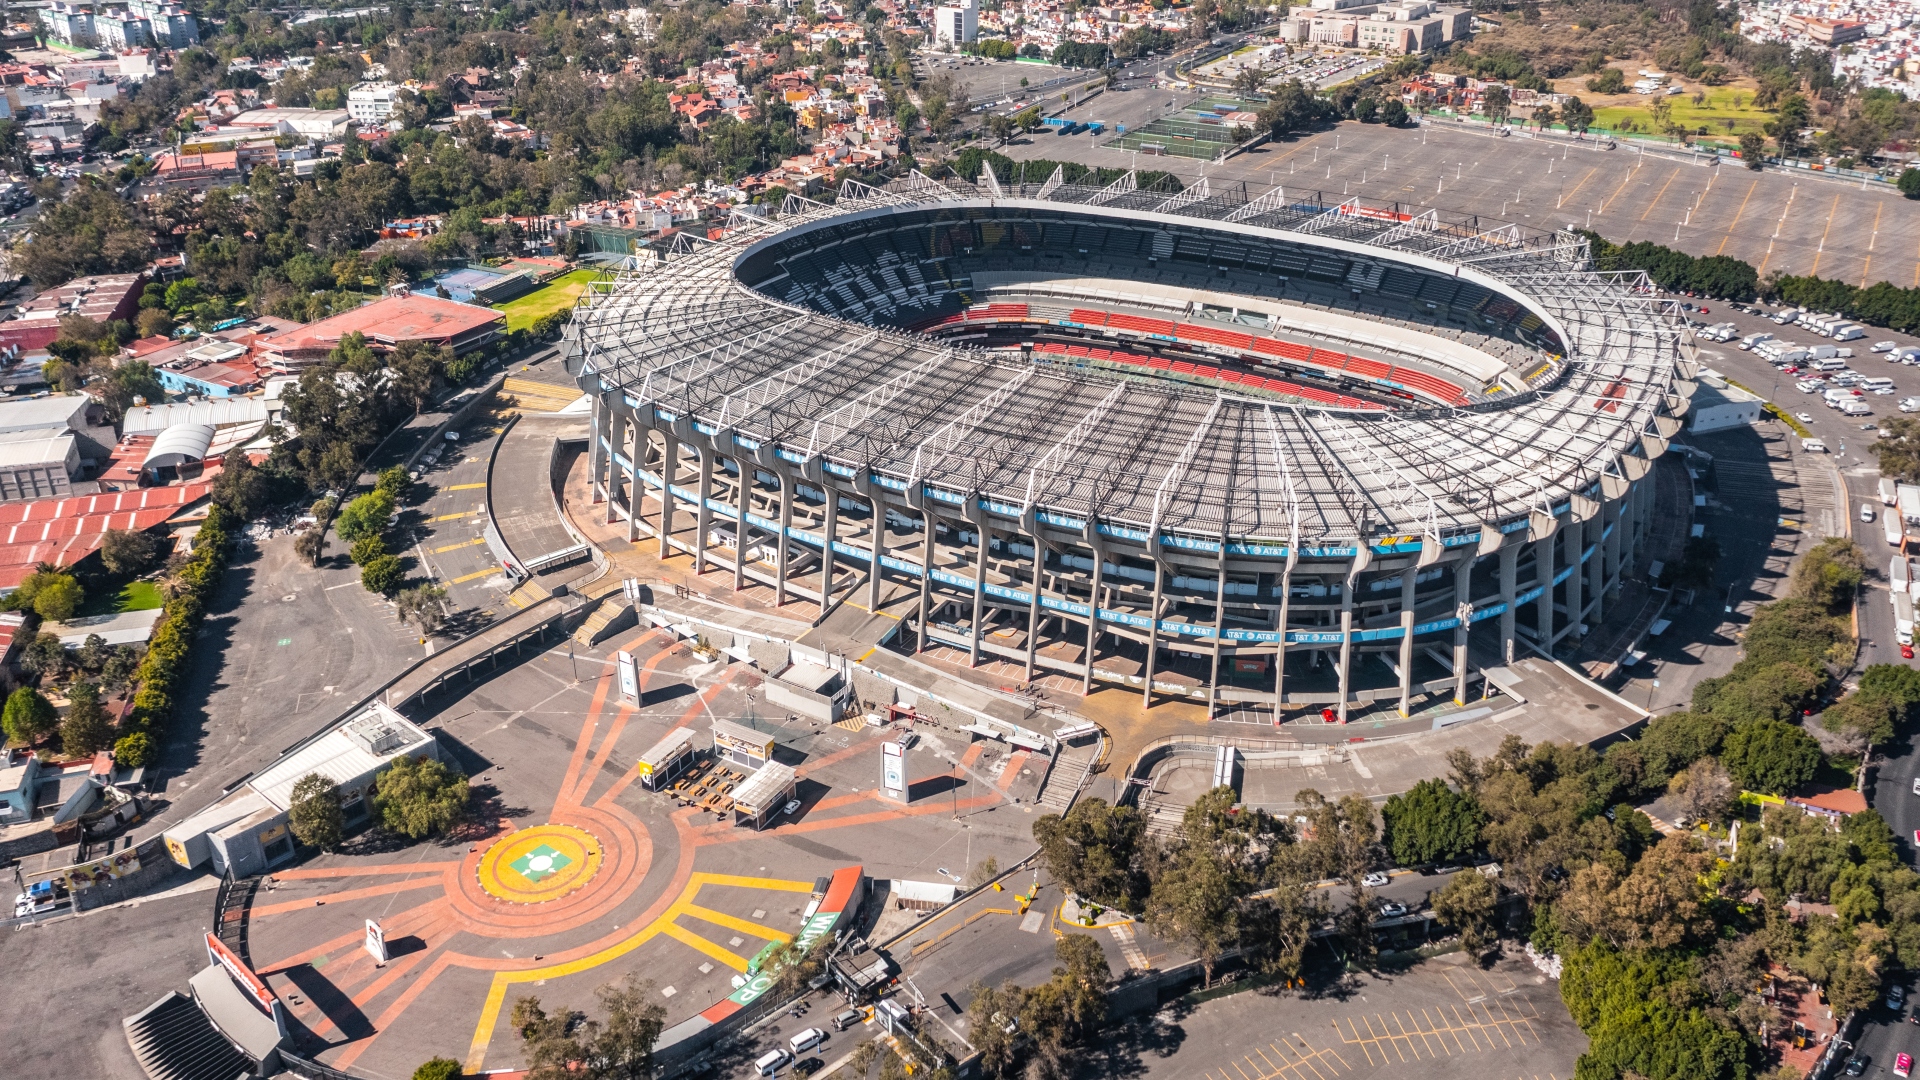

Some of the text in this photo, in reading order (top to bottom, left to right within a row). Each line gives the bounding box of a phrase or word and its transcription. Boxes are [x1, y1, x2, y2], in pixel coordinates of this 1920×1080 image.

[747, 515, 780, 530] AT&T AT&T
[1068, 519, 1086, 529] AT&T
[789, 529, 824, 545] AT&T AT&T
[834, 544, 872, 560] AT&T AT&T
[1195, 542, 1216, 551] AT&T
[1230, 545, 1284, 556] AT&T AT&T
[1299, 547, 1352, 556] AT&T AT&T
[881, 559, 921, 574] AT&T AT&T
[931, 571, 974, 588] AT&T AT&T
[985, 586, 1030, 601] AT&T AT&T
[1041, 599, 1088, 614] AT&T AT&T
[1490, 605, 1505, 616] AT&T
[1100, 611, 1148, 626] AT&T AT&T
[1439, 618, 1456, 629] AT&T
[1161, 623, 1212, 636] AT&T AT&T
[1225, 631, 1277, 641] AT&T AT&T
